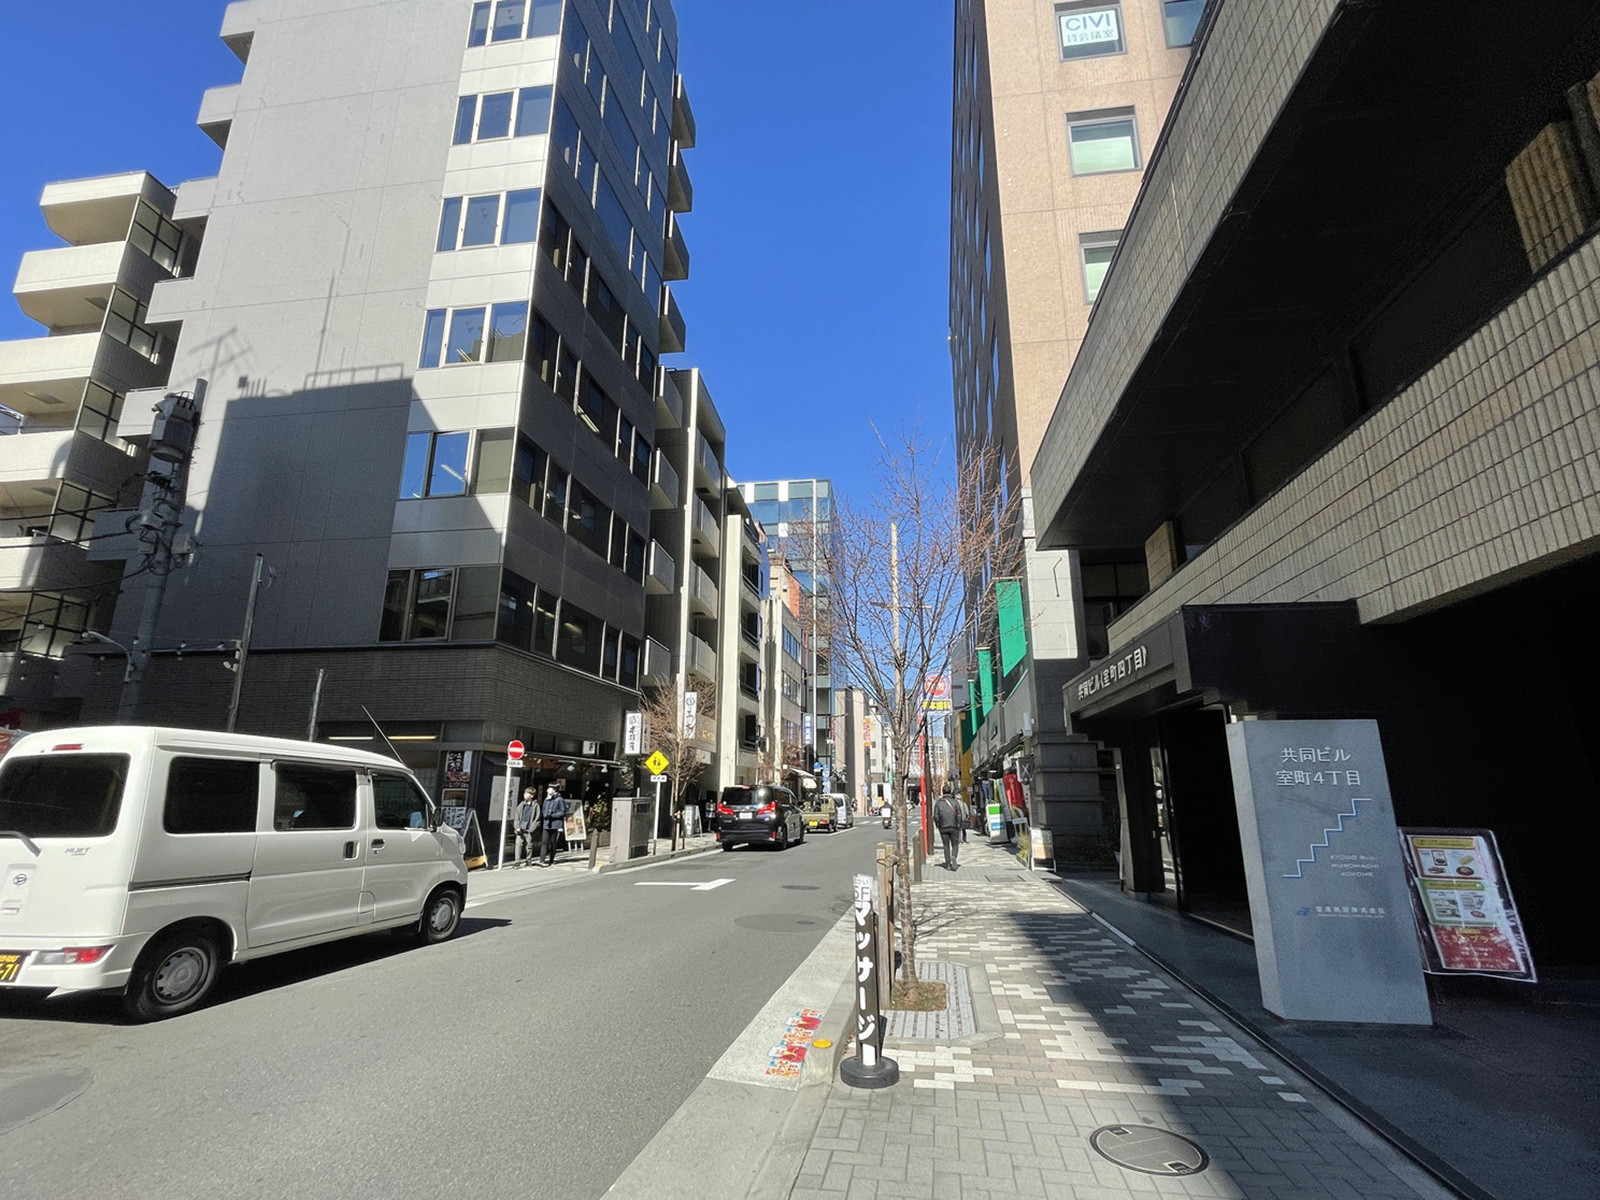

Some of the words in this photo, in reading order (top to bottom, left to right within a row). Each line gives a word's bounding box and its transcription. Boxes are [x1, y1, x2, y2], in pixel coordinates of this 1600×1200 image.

[1066, 13, 1110, 30] CIVI
[1281, 746, 1351, 763] 共同ビル
[1276, 770, 1361, 786] 室町4丁目
[855, 901, 875, 1040] マッサージ
